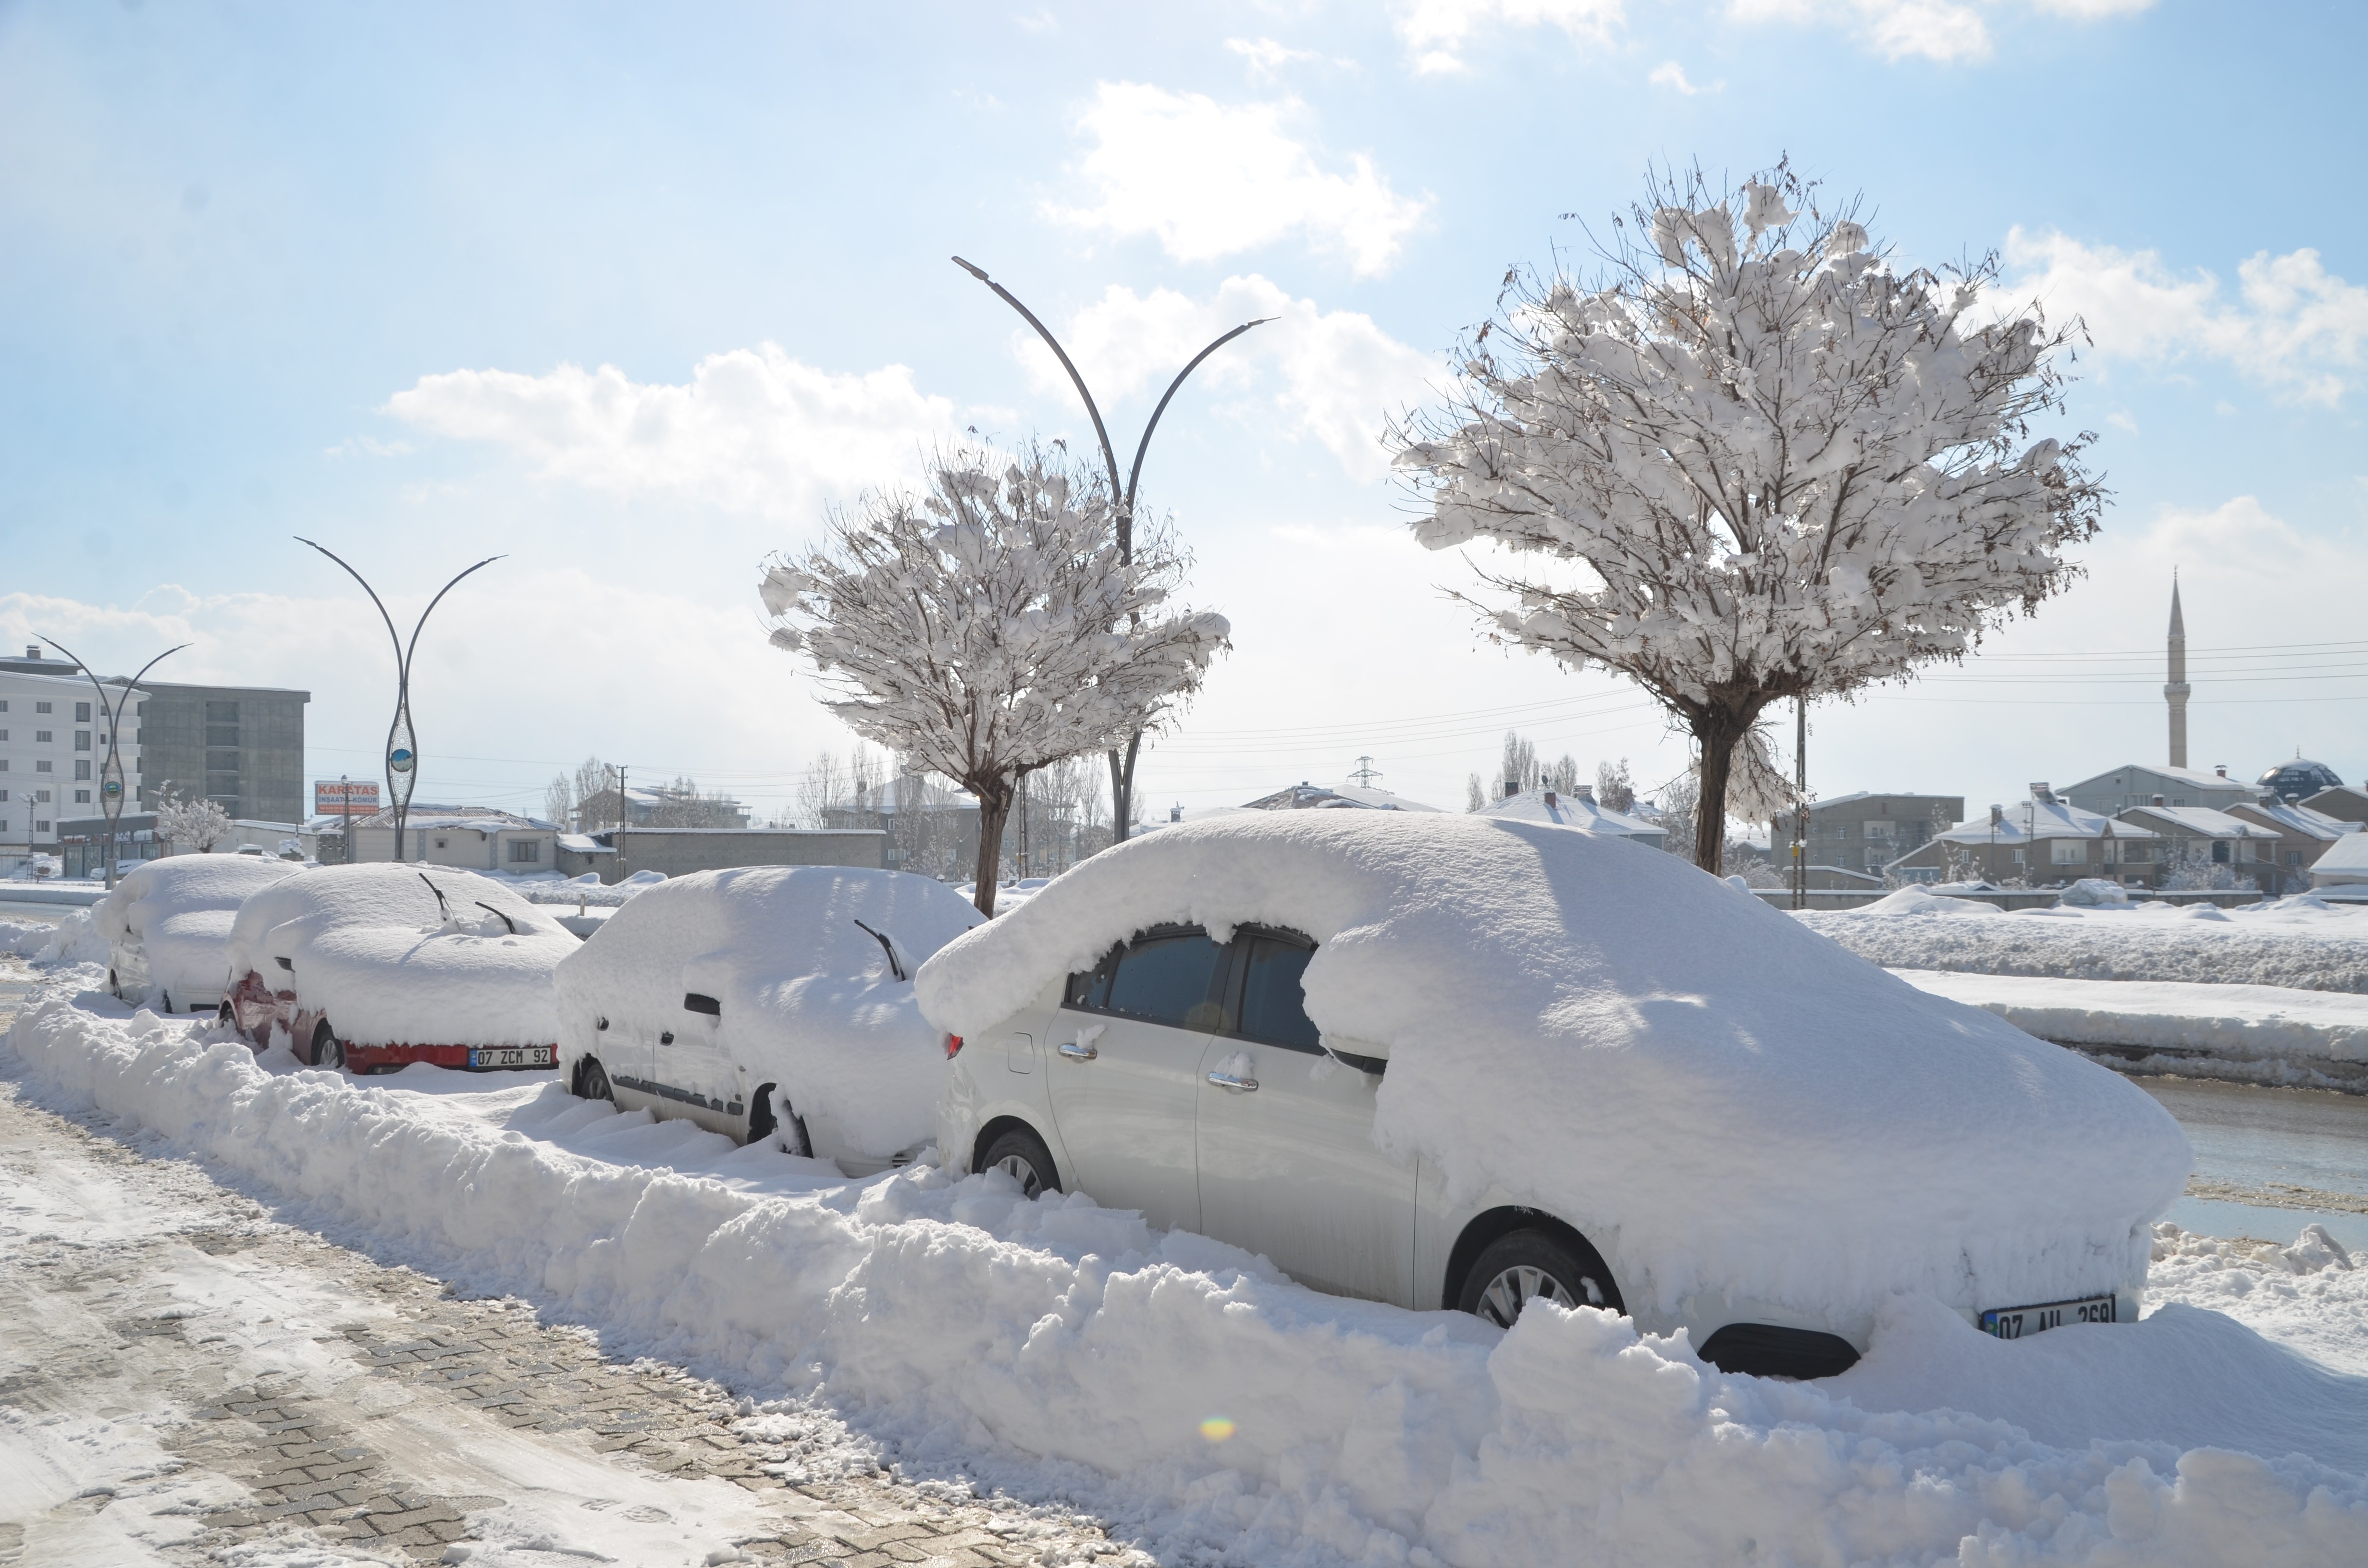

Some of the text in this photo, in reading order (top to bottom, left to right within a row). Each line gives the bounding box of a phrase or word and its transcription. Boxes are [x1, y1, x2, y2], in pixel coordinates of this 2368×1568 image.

[478, 1050, 547, 1065] 07 ZCM 92
[1999, 1314, 2023, 1339] 07
